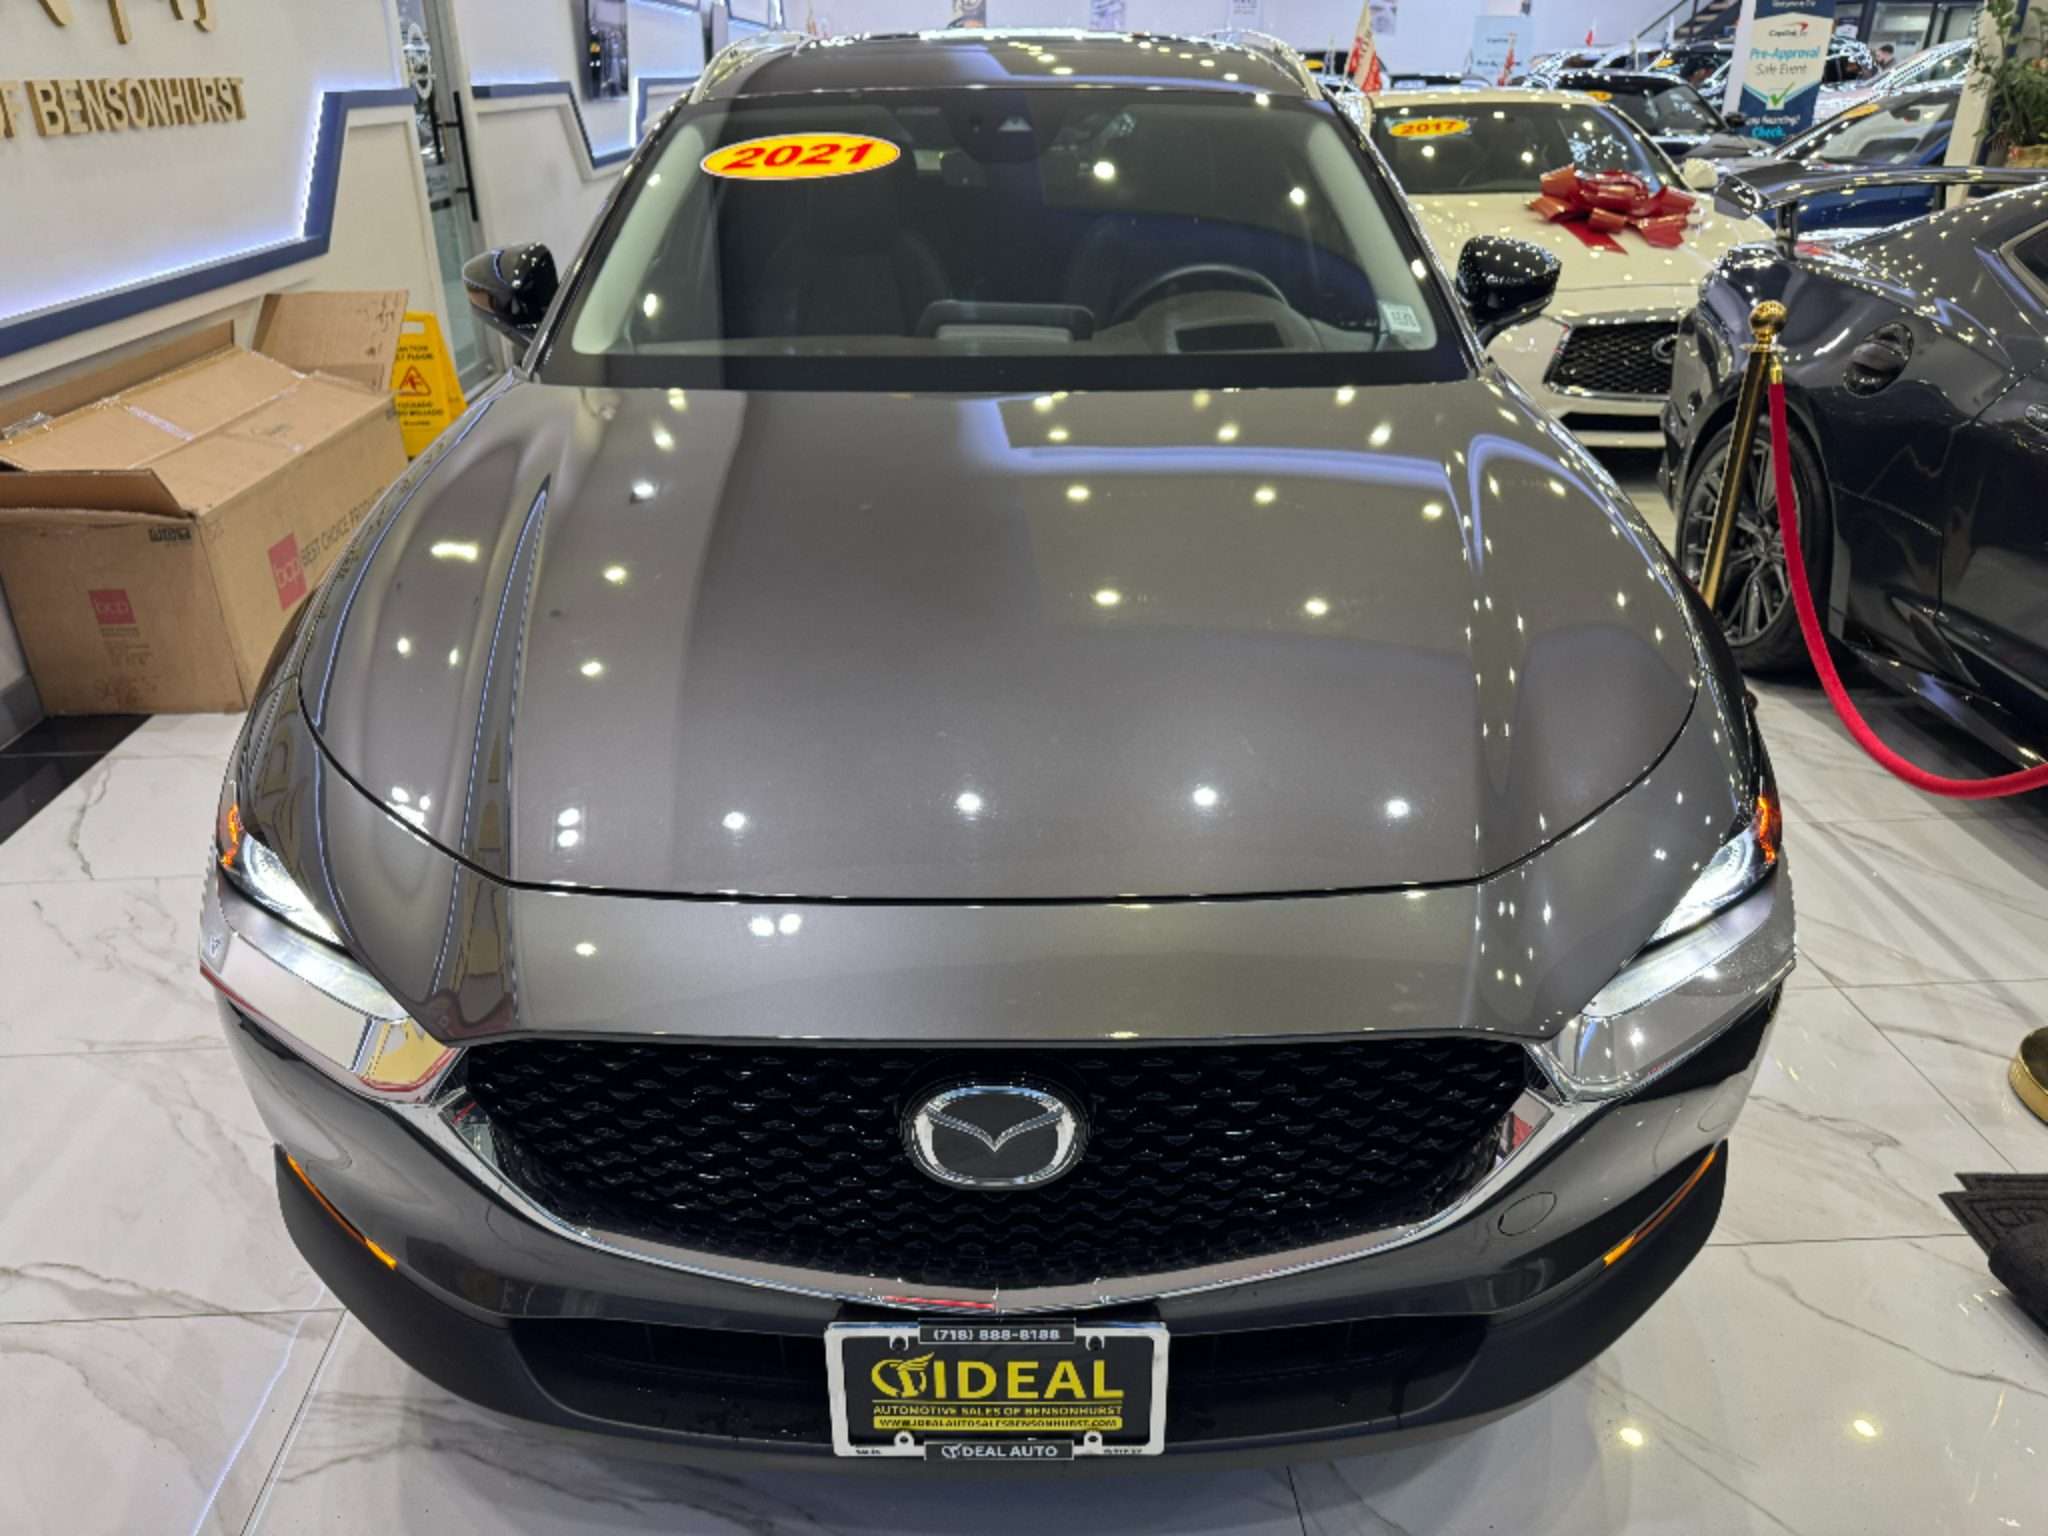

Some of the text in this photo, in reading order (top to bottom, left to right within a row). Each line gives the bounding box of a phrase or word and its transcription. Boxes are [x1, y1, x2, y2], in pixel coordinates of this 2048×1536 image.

[1751, 47, 1820, 60] Pre-Approval
[25, 77, 246, 137] BENSONHURST
[1401, 121, 1458, 135] 2017
[722, 142, 874, 170] 2021
[933, 1328, 1060, 1341] (718) 888-8188
[933, 1360, 1125, 1399] IDEAL
[873, 1406, 1123, 1417] AUTOMOTIVE SALES OF BENSONHURST
[1010, 1445, 1058, 1457] AUTO
